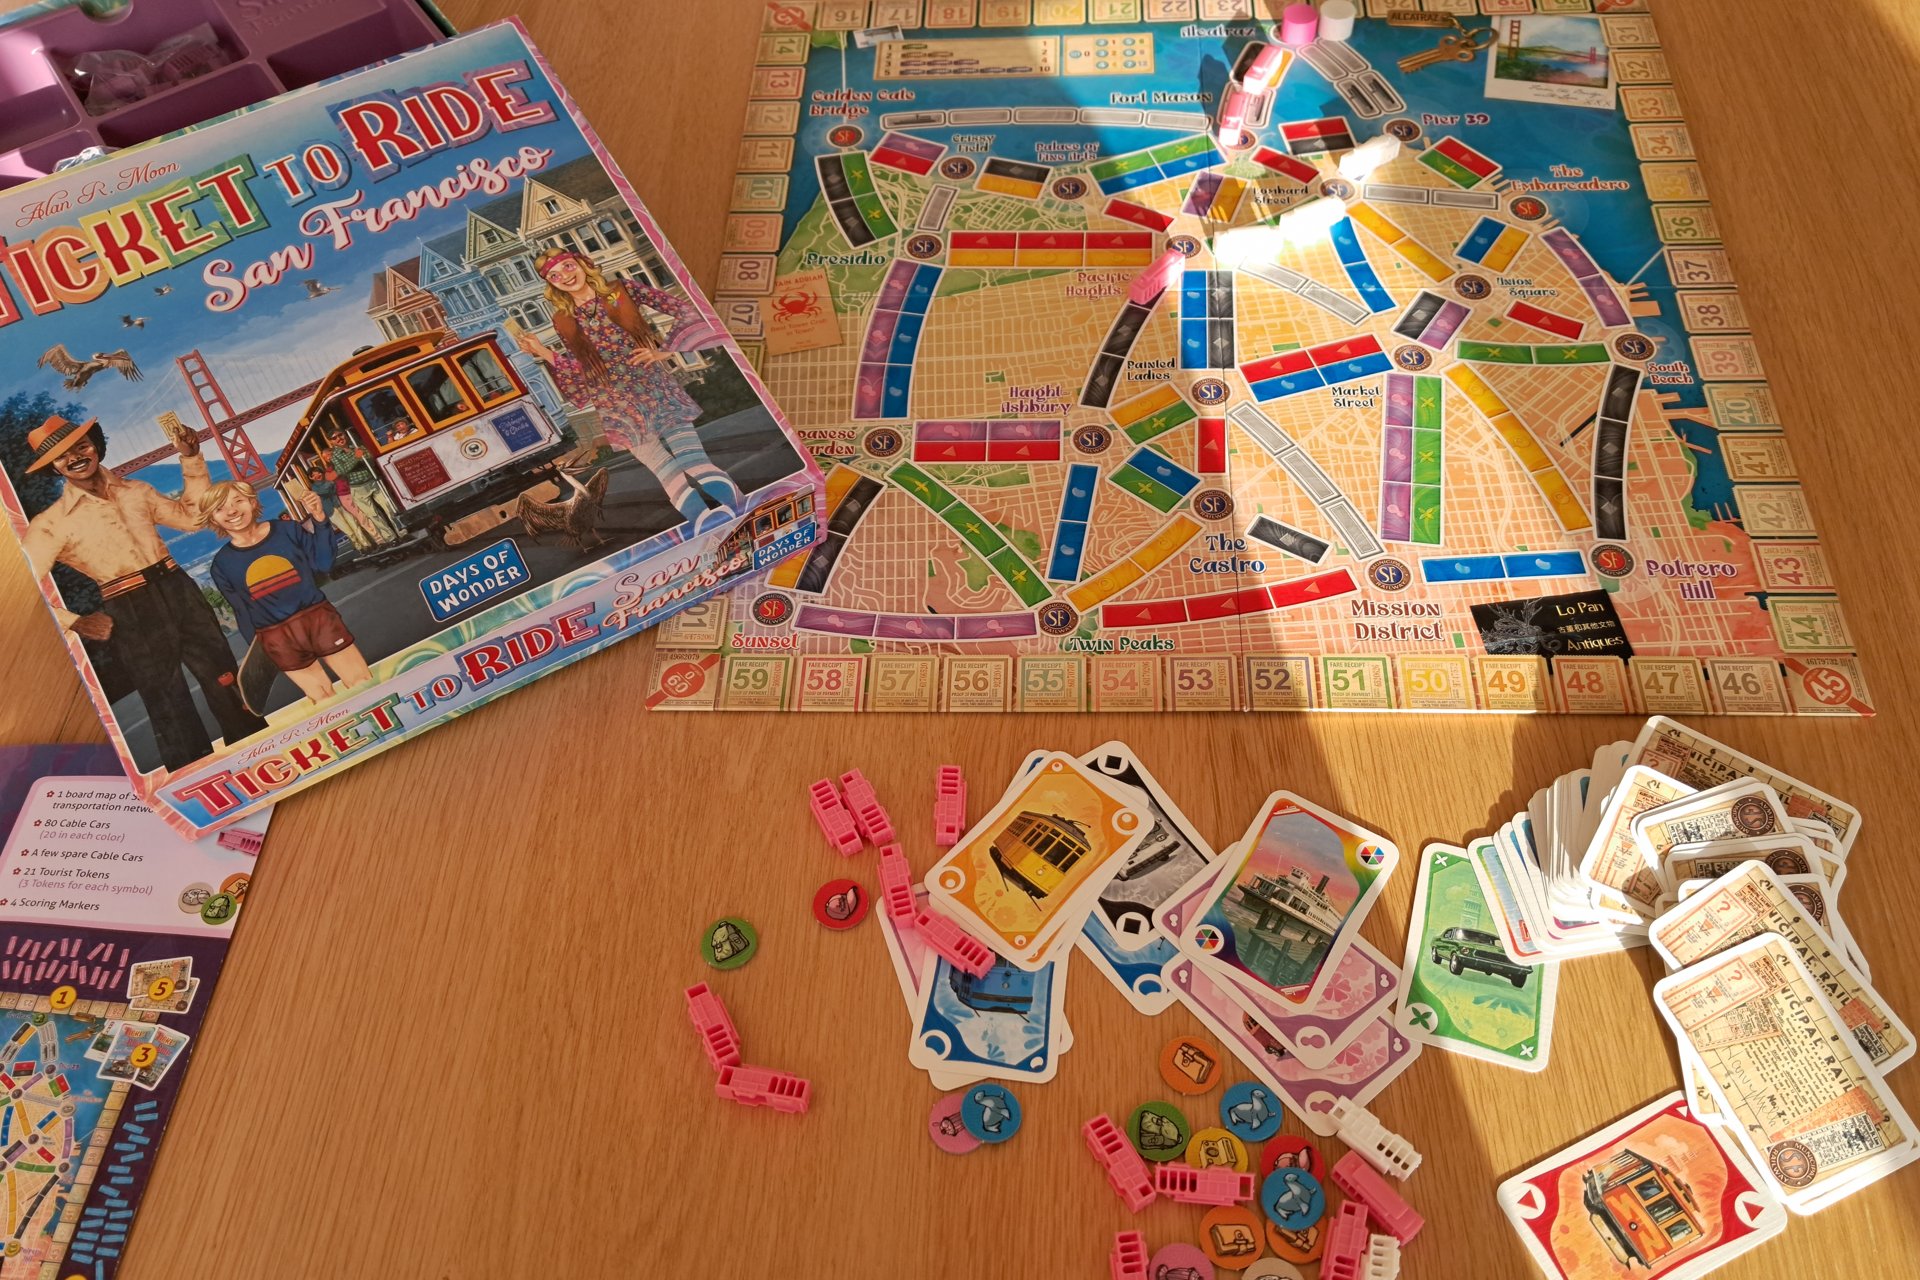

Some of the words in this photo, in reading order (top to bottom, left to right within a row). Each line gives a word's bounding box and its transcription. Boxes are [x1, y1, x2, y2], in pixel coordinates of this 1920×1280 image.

[888, 8, 913, 21] 17
[942, 7, 967, 18] 18
[1107, 2, 1133, 14] 21
[1162, 1, 1187, 12] 22
[834, 10, 859, 22] 16
[1391, 13, 1440, 21] ALCATRAZ
[1619, 25, 1640, 43] 31
[776, 38, 797, 55] 14
[1630, 60, 1650, 79] 32
[770, 71, 789, 89] 13
[811, 89, 872, 102] Golden
[1109, 90, 1148, 105] Fort
[1152, 92, 1213, 104] Mason
[765, 106, 784, 124] 12
[1641, 96, 1662, 117] 33
[1422, 113, 1460, 125] Pier
[1465, 113, 1490, 124] 39
[263, 144, 344, 200] TO
[338, 67, 545, 172] RIDE
[757, 142, 780, 160] 11
[1035, 141, 1080, 152] Palace
[1651, 134, 1673, 156] 34
[1550, 165, 1584, 177] The
[750, 180, 772, 199] 10
[1510, 177, 1630, 191] Embarcadero
[15, 190, 72, 228] Alan
[77, 180, 114, 206] R.
[118, 160, 180, 192] Moon
[202, 240, 315, 313] San
[299, 145, 555, 251] Francisco
[745, 220, 767, 240] 09
[1675, 216, 1698, 238] 36
[806, 251, 886, 265] Presidio
[737, 260, 761, 281] 08
[1685, 259, 1711, 281] 37
[1497, 277, 1533, 287] Union
[1065, 284, 1121, 300] Heights
[1509, 287, 1557, 298] Square
[731, 303, 754, 326] 07
[1701, 304, 1725, 327] 38
[1127, 359, 1176, 370] Painted
[1648, 362, 1690, 373] South
[1715, 350, 1740, 374] 39
[1127, 370, 1171, 381] Ladies
[1651, 373, 1693, 385] Beach
[1331, 385, 1381, 397] Market
[1333, 397, 1374, 408] Street
[1729, 399, 1752, 424] 40
[1744, 450, 1770, 476] 41
[1762, 501, 1787, 530] 42
[756, 536, 791, 559] DAYS
[792, 528, 812, 542] OF
[1205, 534, 1246, 551] The
[430, 561, 480, 596] DAYS
[483, 549, 511, 570] OF
[1189, 556, 1267, 573] Castro
[1645, 558, 1737, 578] Potrero
[1777, 556, 1804, 587] 43
[611, 554, 703, 609] San
[1380, 566, 1398, 583] SF
[602, 555, 748, 632] Francisco
[1679, 580, 1716, 600] Hill
[763, 600, 782, 618] SF
[1351, 598, 1441, 617] Mission
[1555, 603, 1576, 617] Lo
[1578, 601, 1605, 614] Pan
[1047, 610, 1065, 628] SF
[1355, 621, 1445, 641] District
[1793, 614, 1823, 645] 44
[731, 632, 799, 649] Sunset
[1069, 636, 1114, 652] Twin
[1119, 634, 1175, 652] Peaks
[1566, 635, 1625, 652] Antiques
[667, 674, 689, 694] 60
[732, 668, 769, 690] 59
[806, 669, 843, 691] 58
[879, 669, 916, 692] 57
[953, 669, 990, 692] 56
[1026, 669, 1065, 691] 55
[1101, 669, 1139, 692] 54
[1177, 668, 1215, 692] 53
[1254, 668, 1292, 691] 52
[1331, 669, 1366, 692] 51
[1410, 669, 1448, 693] 50
[1488, 670, 1526, 693] 49
[1567, 671, 1605, 694] 48
[1643, 671, 1680, 695] 47
[1722, 672, 1761, 696] 46
[1809, 670, 1846, 702] 45
[180, 698, 397, 813] TICKET
[404, 676, 457, 712] TO
[460, 603, 600, 684] RIDE
[236, 740, 277, 766] Alan
[306, 706, 351, 733] Moon
[56, 790, 64, 798] 1
[65, 790, 94, 800] board
[97, 791, 117, 801] map
[118, 791, 131, 800] of
[52, 801, 121, 813] transportation
[44, 819, 57, 827] 80
[59, 818, 87, 829] Cable
[89, 820, 111, 829] Cars
[39, 831, 56, 840] (20
[57, 831, 68, 839] in
[69, 831, 94, 841] each
[95, 832, 126, 843] color)
[31, 848, 38, 857] A
[40, 848, 58, 858] few
[60, 850, 88, 860] spare
[91, 850, 119, 861] Cable
[121, 852, 144, 862] Cars
[23, 867, 35, 876] 21
[39, 867, 73, 878] Tourist
[74, 869, 110, 880] Tokens
[18, 879, 28, 889] (3
[31, 879, 65, 890] Tokens
[66, 881, 82, 892] for
[83, 883, 109, 893] each
[111, 884, 153, 896] symbol)
[10, 898, 17, 907] 4
[18, 898, 56, 911] Scoring
[58, 900, 100, 911] Markers
[57, 990, 70, 1005] 1
[154, 981, 169, 996] 5
[139, 1047, 151, 1063] 3
